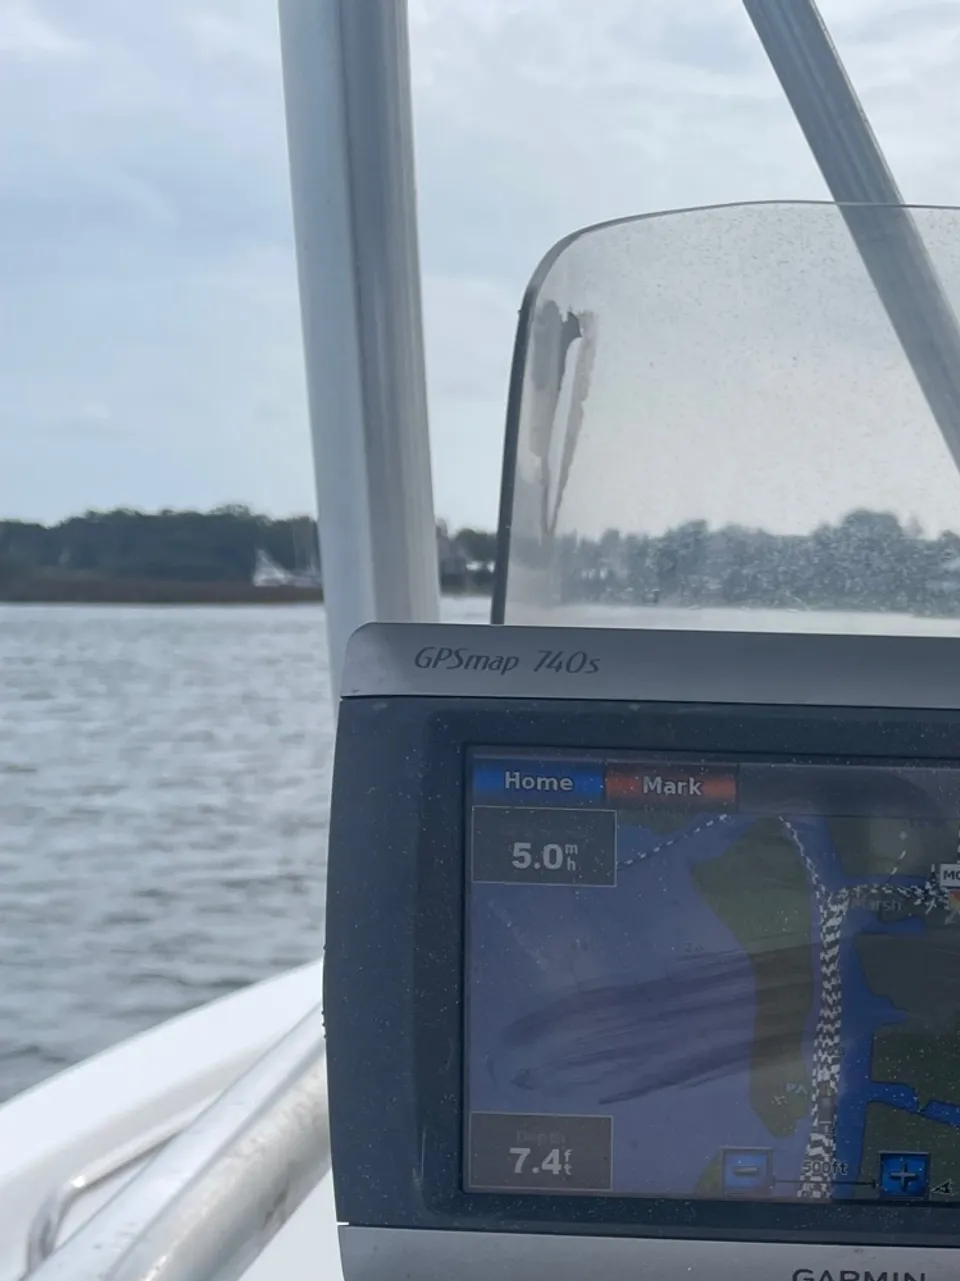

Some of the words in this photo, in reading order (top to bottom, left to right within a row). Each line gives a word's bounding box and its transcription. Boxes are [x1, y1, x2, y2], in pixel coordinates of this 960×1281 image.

[414, 646, 519, 675] GPSmap
[533, 649, 600, 675] 740s
[504, 771, 574, 792] Home
[642, 774, 703, 797] Mark
